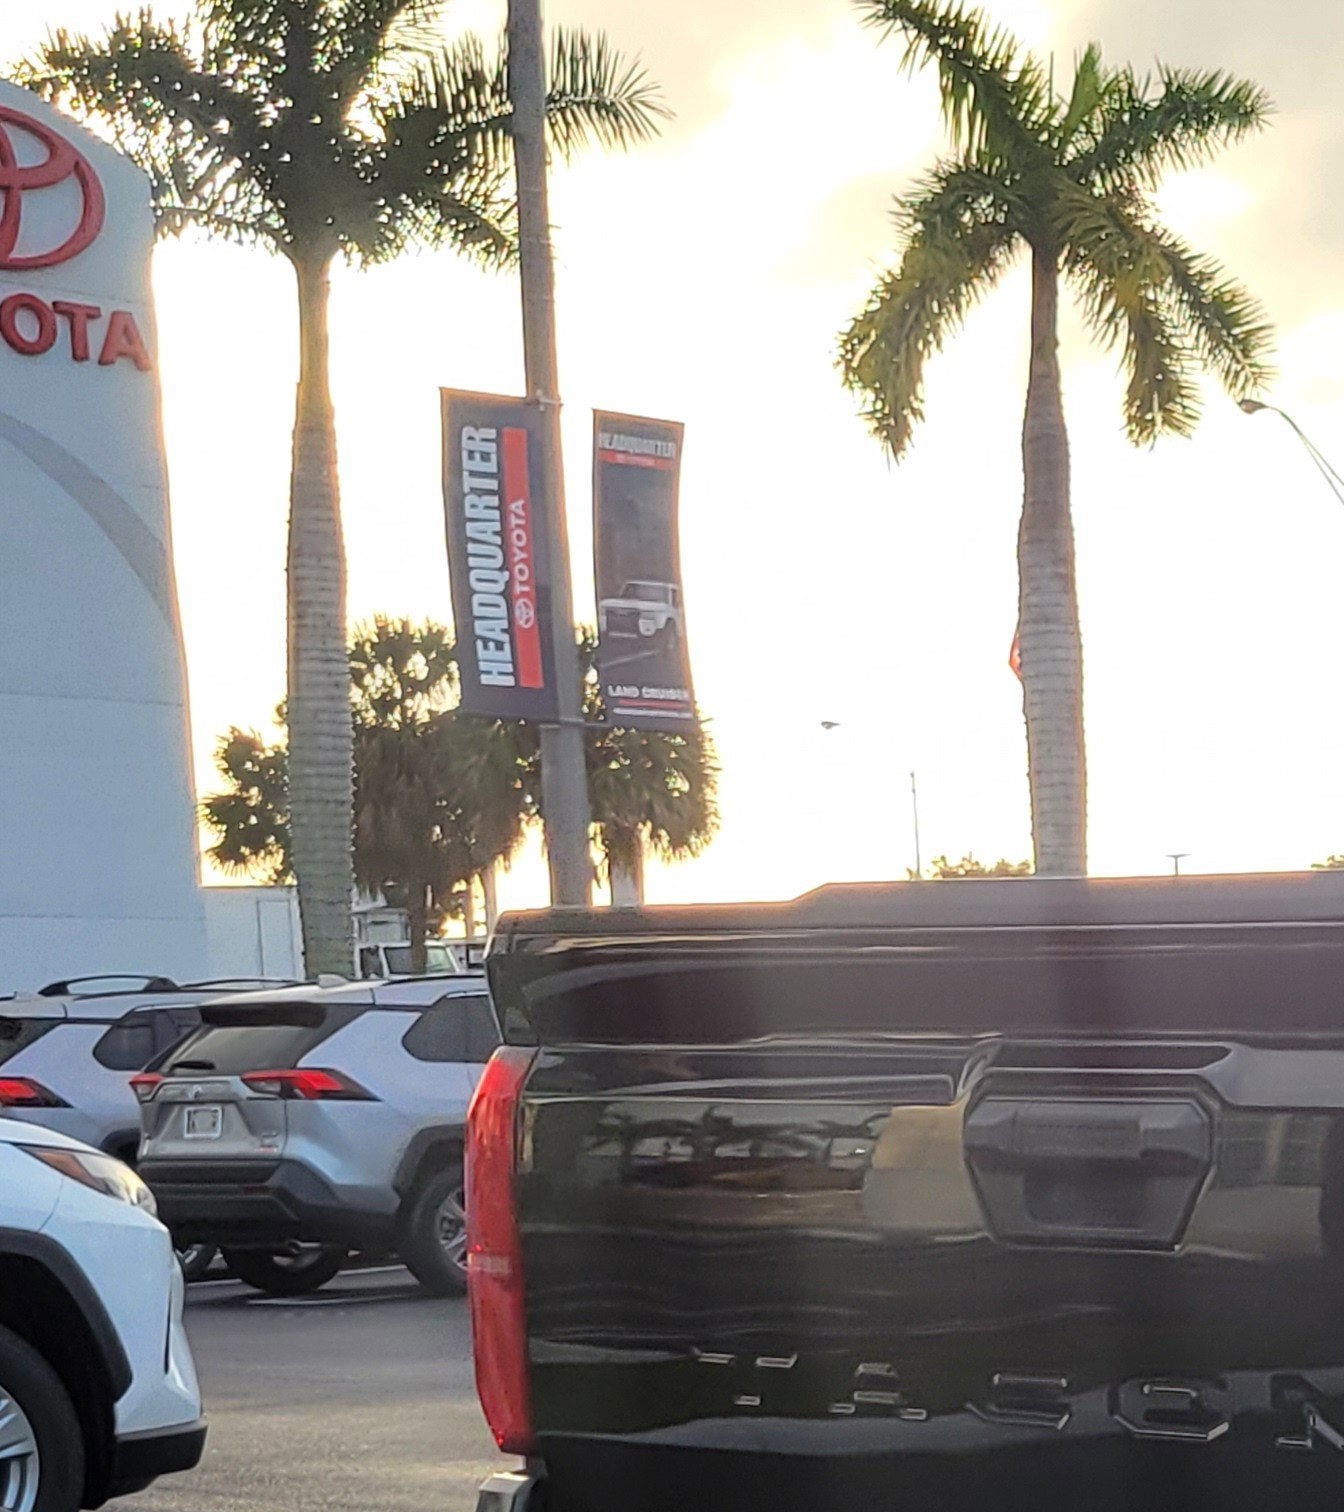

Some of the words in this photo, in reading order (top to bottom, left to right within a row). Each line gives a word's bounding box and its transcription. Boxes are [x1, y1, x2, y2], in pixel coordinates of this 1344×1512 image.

[461, 425, 515, 687] HEADQUARTER
[508, 498, 531, 594] TOYOTA
[608, 685, 639, 697] LAND
